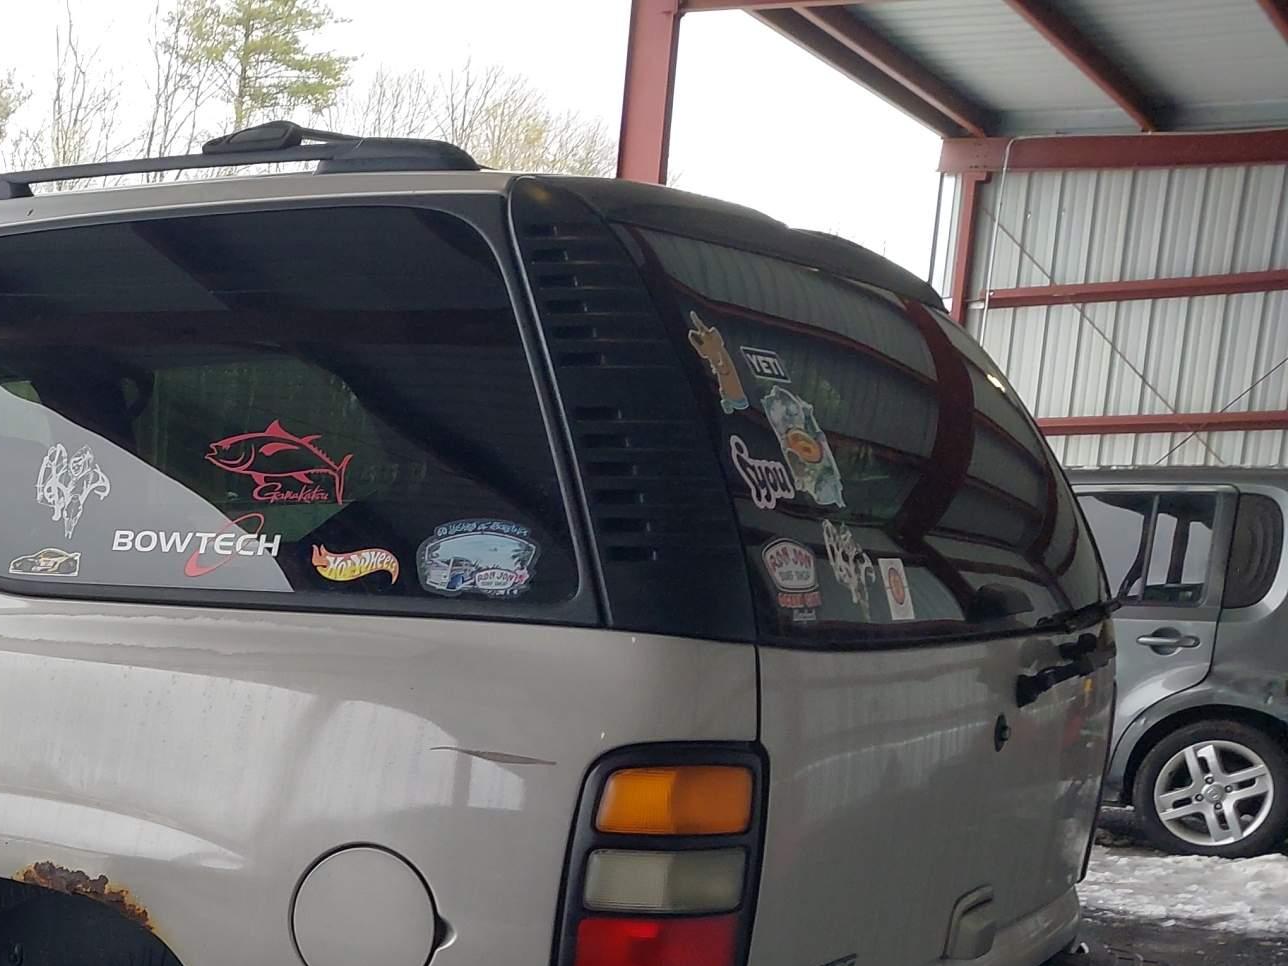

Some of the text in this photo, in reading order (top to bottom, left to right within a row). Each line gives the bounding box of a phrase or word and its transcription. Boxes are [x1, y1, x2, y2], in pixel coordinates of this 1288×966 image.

[747, 354, 785, 377] YETI
[112, 529, 282, 557] BOWTECH
[478, 571, 496, 583] RON
